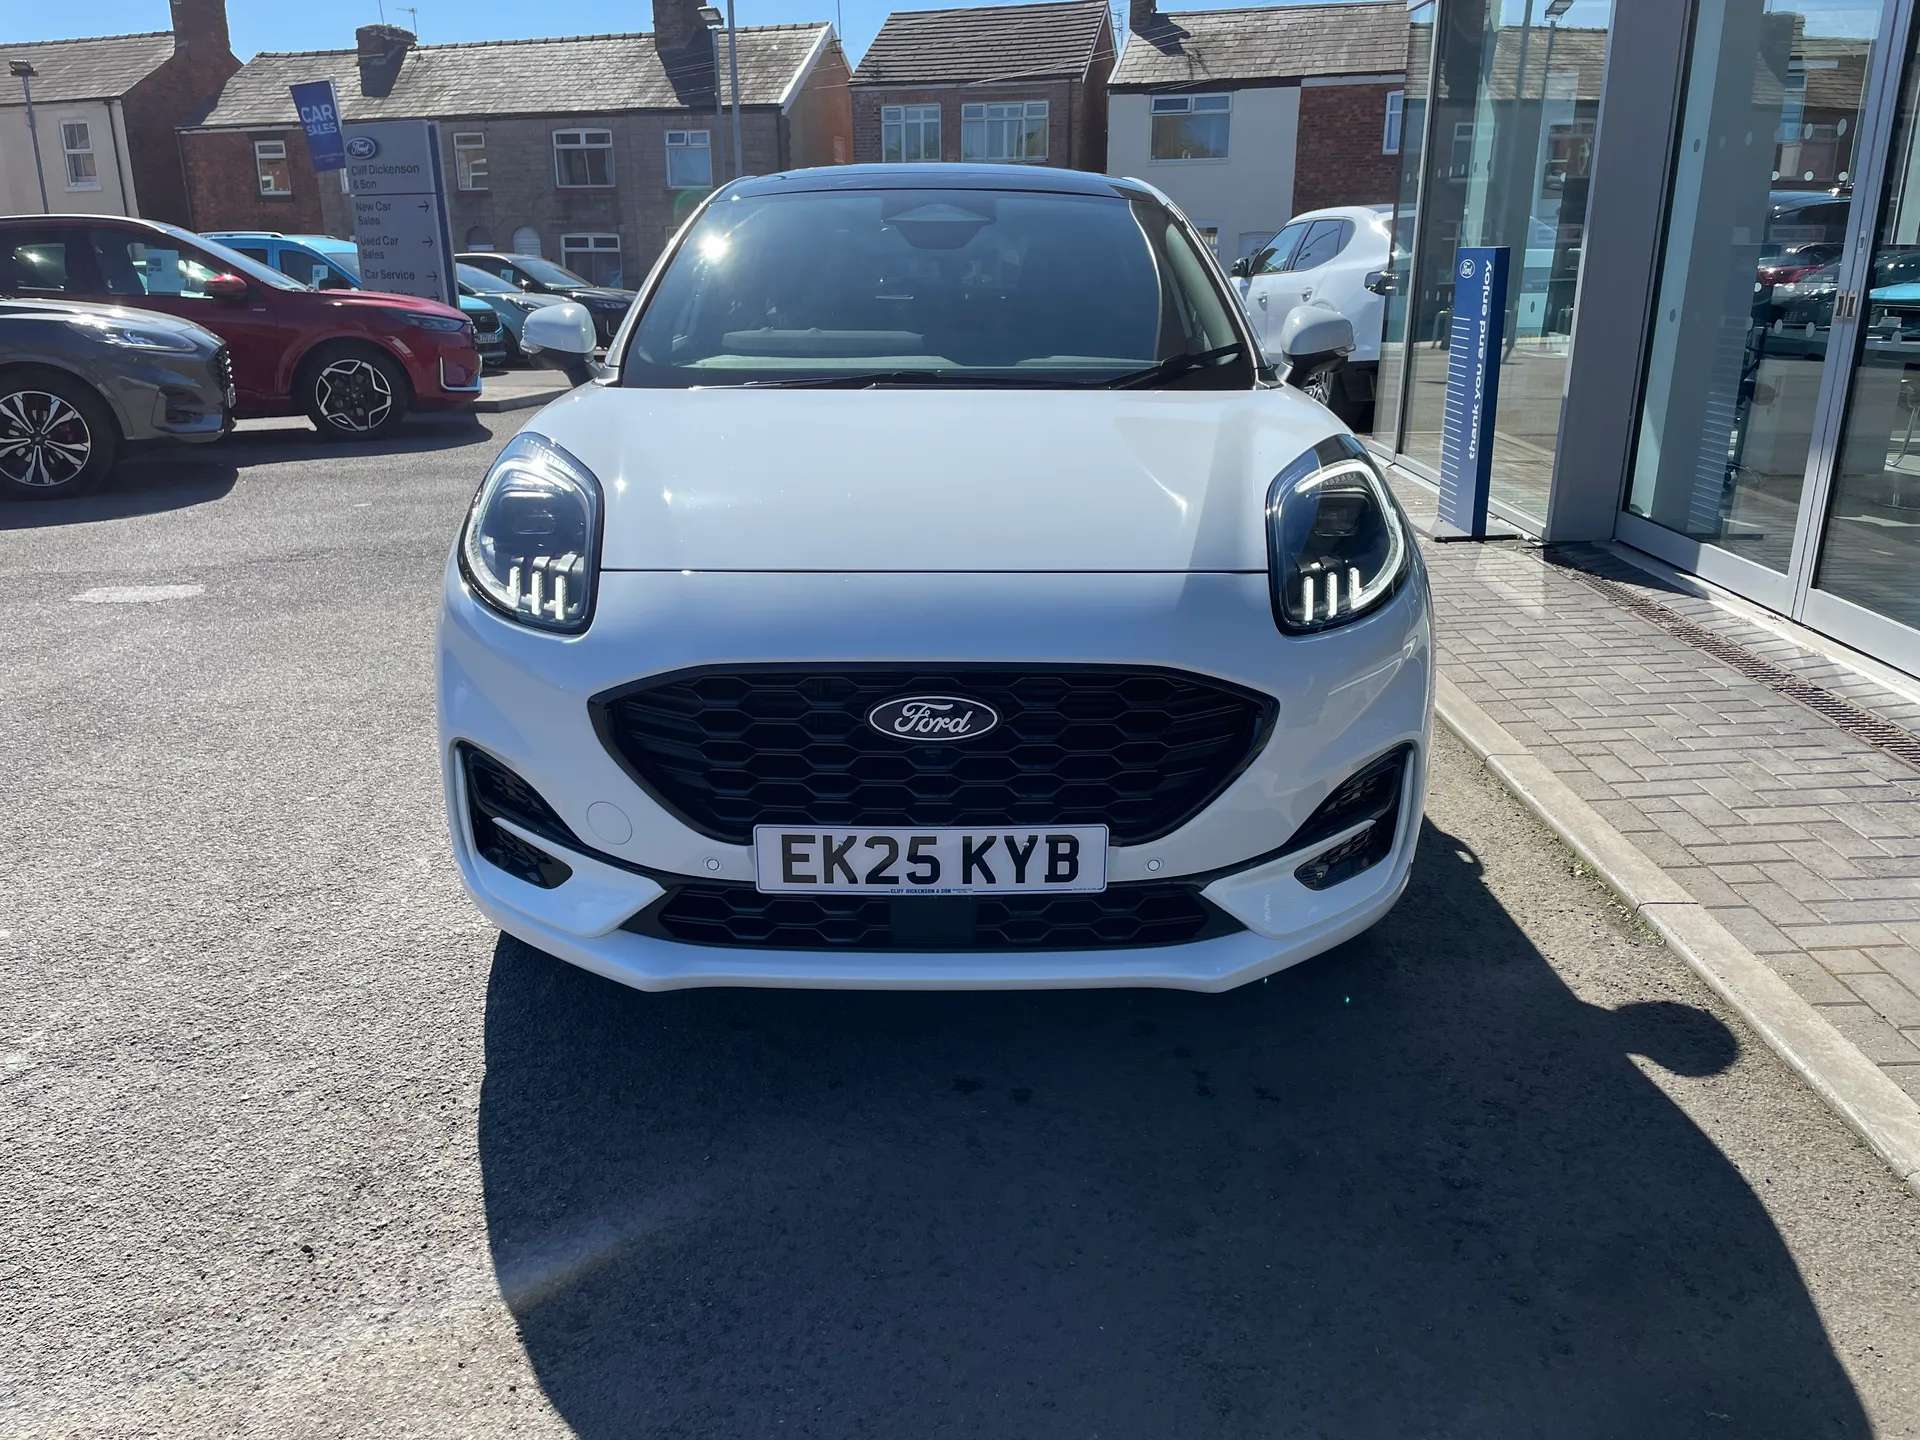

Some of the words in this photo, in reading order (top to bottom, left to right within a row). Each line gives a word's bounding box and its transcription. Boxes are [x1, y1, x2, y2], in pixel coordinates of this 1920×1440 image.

[301, 104, 334, 122] CAR
[306, 122, 337, 136] SALES
[369, 163, 420, 175] Dickenson
[360, 179, 377, 189] Son
[356, 202, 374, 212] New
[375, 201, 391, 212] Car
[358, 215, 380, 225] Sales
[361, 236, 381, 246] Used
[383, 235, 399, 246] Car
[363, 249, 384, 259] Sales
[364, 269, 379, 280] Car
[380, 269, 415, 280] Service
[1481, 260, 1493, 316] enjoy
[1477, 320, 1487, 360] and
[1474, 363, 1483, 399] you
[1468, 403, 1480, 460] thank
[894, 702, 973, 733] Ford
[780, 834, 941, 885] EK25
[962, 834, 1080, 885] KYB
